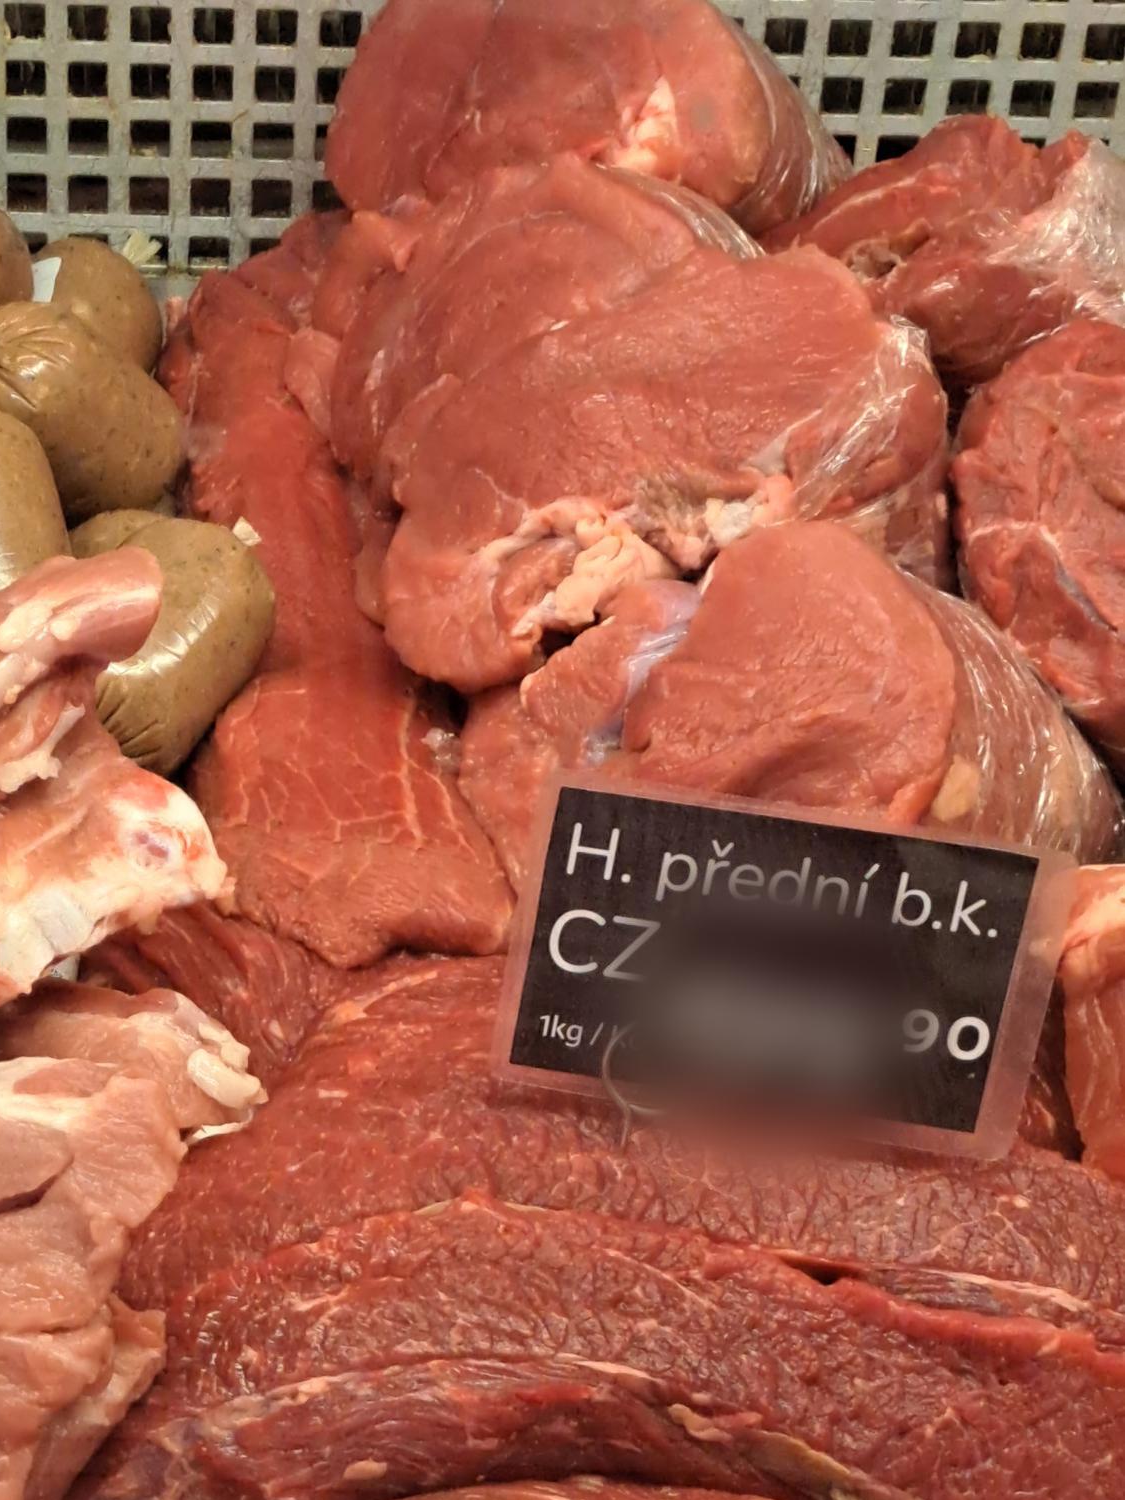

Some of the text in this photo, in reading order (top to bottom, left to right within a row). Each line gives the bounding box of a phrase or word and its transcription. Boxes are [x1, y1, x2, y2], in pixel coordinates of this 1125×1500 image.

[565, 822, 999, 939] H. přední b.k.
[547, 908, 661, 982] CZ
[539, 1014, 584, 1048] 1kg
[902, 1008, 990, 1061] 90
